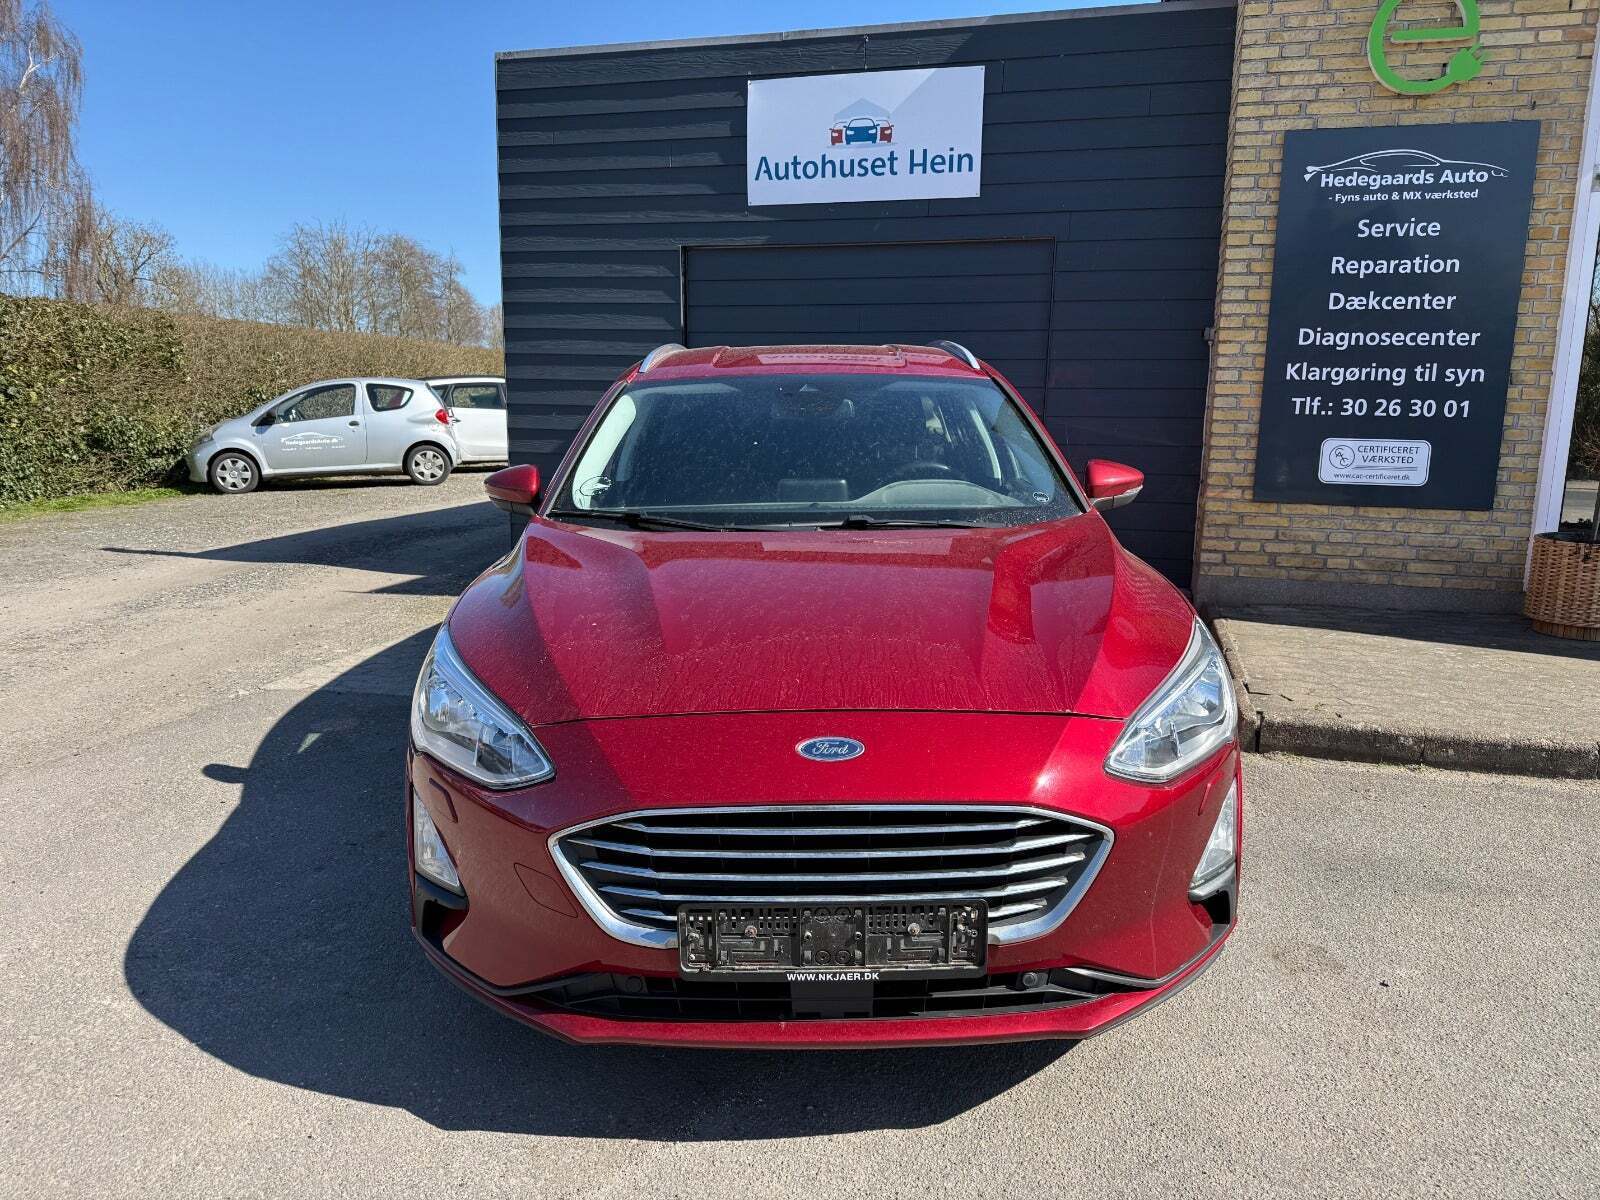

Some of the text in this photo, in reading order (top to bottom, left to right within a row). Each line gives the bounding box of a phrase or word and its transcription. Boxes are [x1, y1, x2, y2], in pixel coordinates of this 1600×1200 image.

[755, 147, 974, 181] Autohuset Hein
[1320, 169, 1489, 190] Hedegaards Auto
[1335, 193, 1360, 203] Fyns
[1363, 192, 1389, 201] auto
[1391, 191, 1400, 200] &
[1402, 191, 1422, 200] MX
[1425, 189, 1479, 200] værksted
[1357, 218, 1441, 238] Service
[1331, 254, 1460, 278] Reparation
[1328, 291, 1457, 310] Dækcenter
[1298, 328, 1481, 350] Diagnosecenter
[1285, 362, 1485, 387] Klargøring til syn
[1292, 397, 1470, 418] Tlf.: 30 26 30 01
[1357, 445, 1420, 454] CERTIFICERET
[1362, 455, 1414, 464] VÆRKSTED
[812, 741, 849, 755] Ford
[786, 972, 880, 981] WWW.NKJAER.DK
